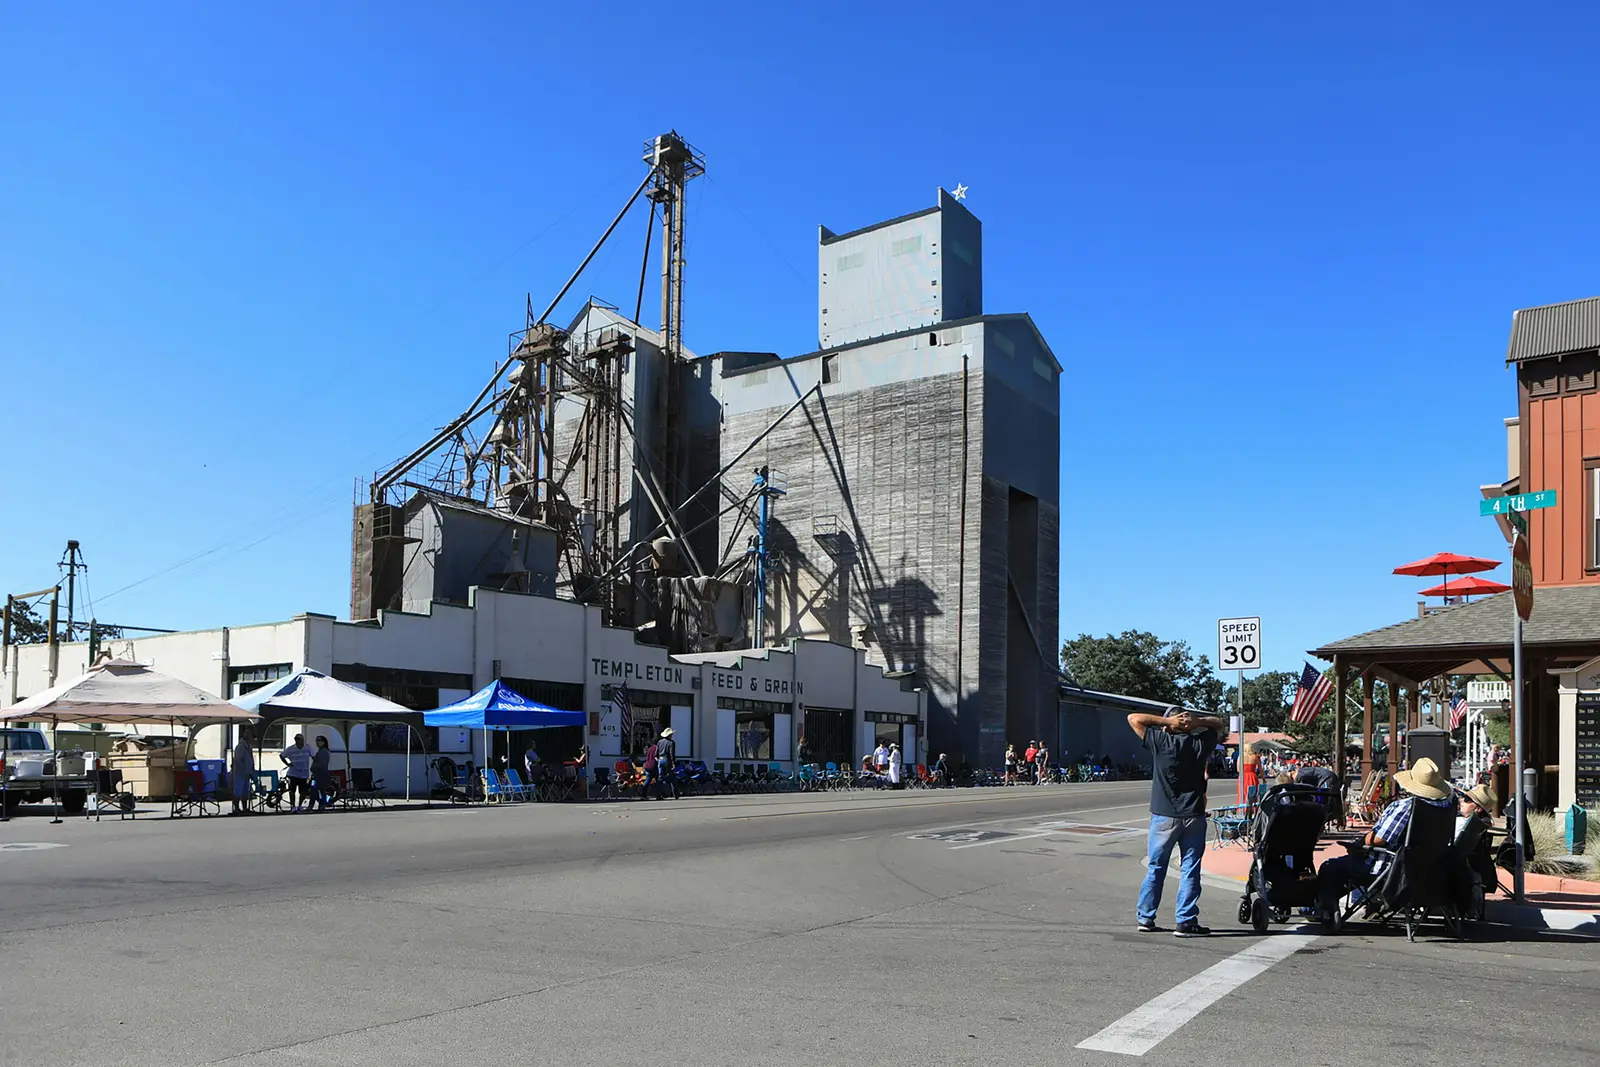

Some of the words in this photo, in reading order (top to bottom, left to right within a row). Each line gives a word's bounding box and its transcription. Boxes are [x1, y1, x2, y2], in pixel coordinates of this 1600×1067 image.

[1535, 494, 1545, 502] ST
[1513, 556, 1532, 597] STOP
[1222, 623, 1257, 633] SPEED
[1225, 634, 1253, 643] LIMIT
[1223, 645, 1257, 665] 30
[591, 658, 682, 684] TEMPLETON
[712, 672, 743, 690] FEED
[750, 677, 758, 692] &
[765, 679, 803, 695] GRAIN
